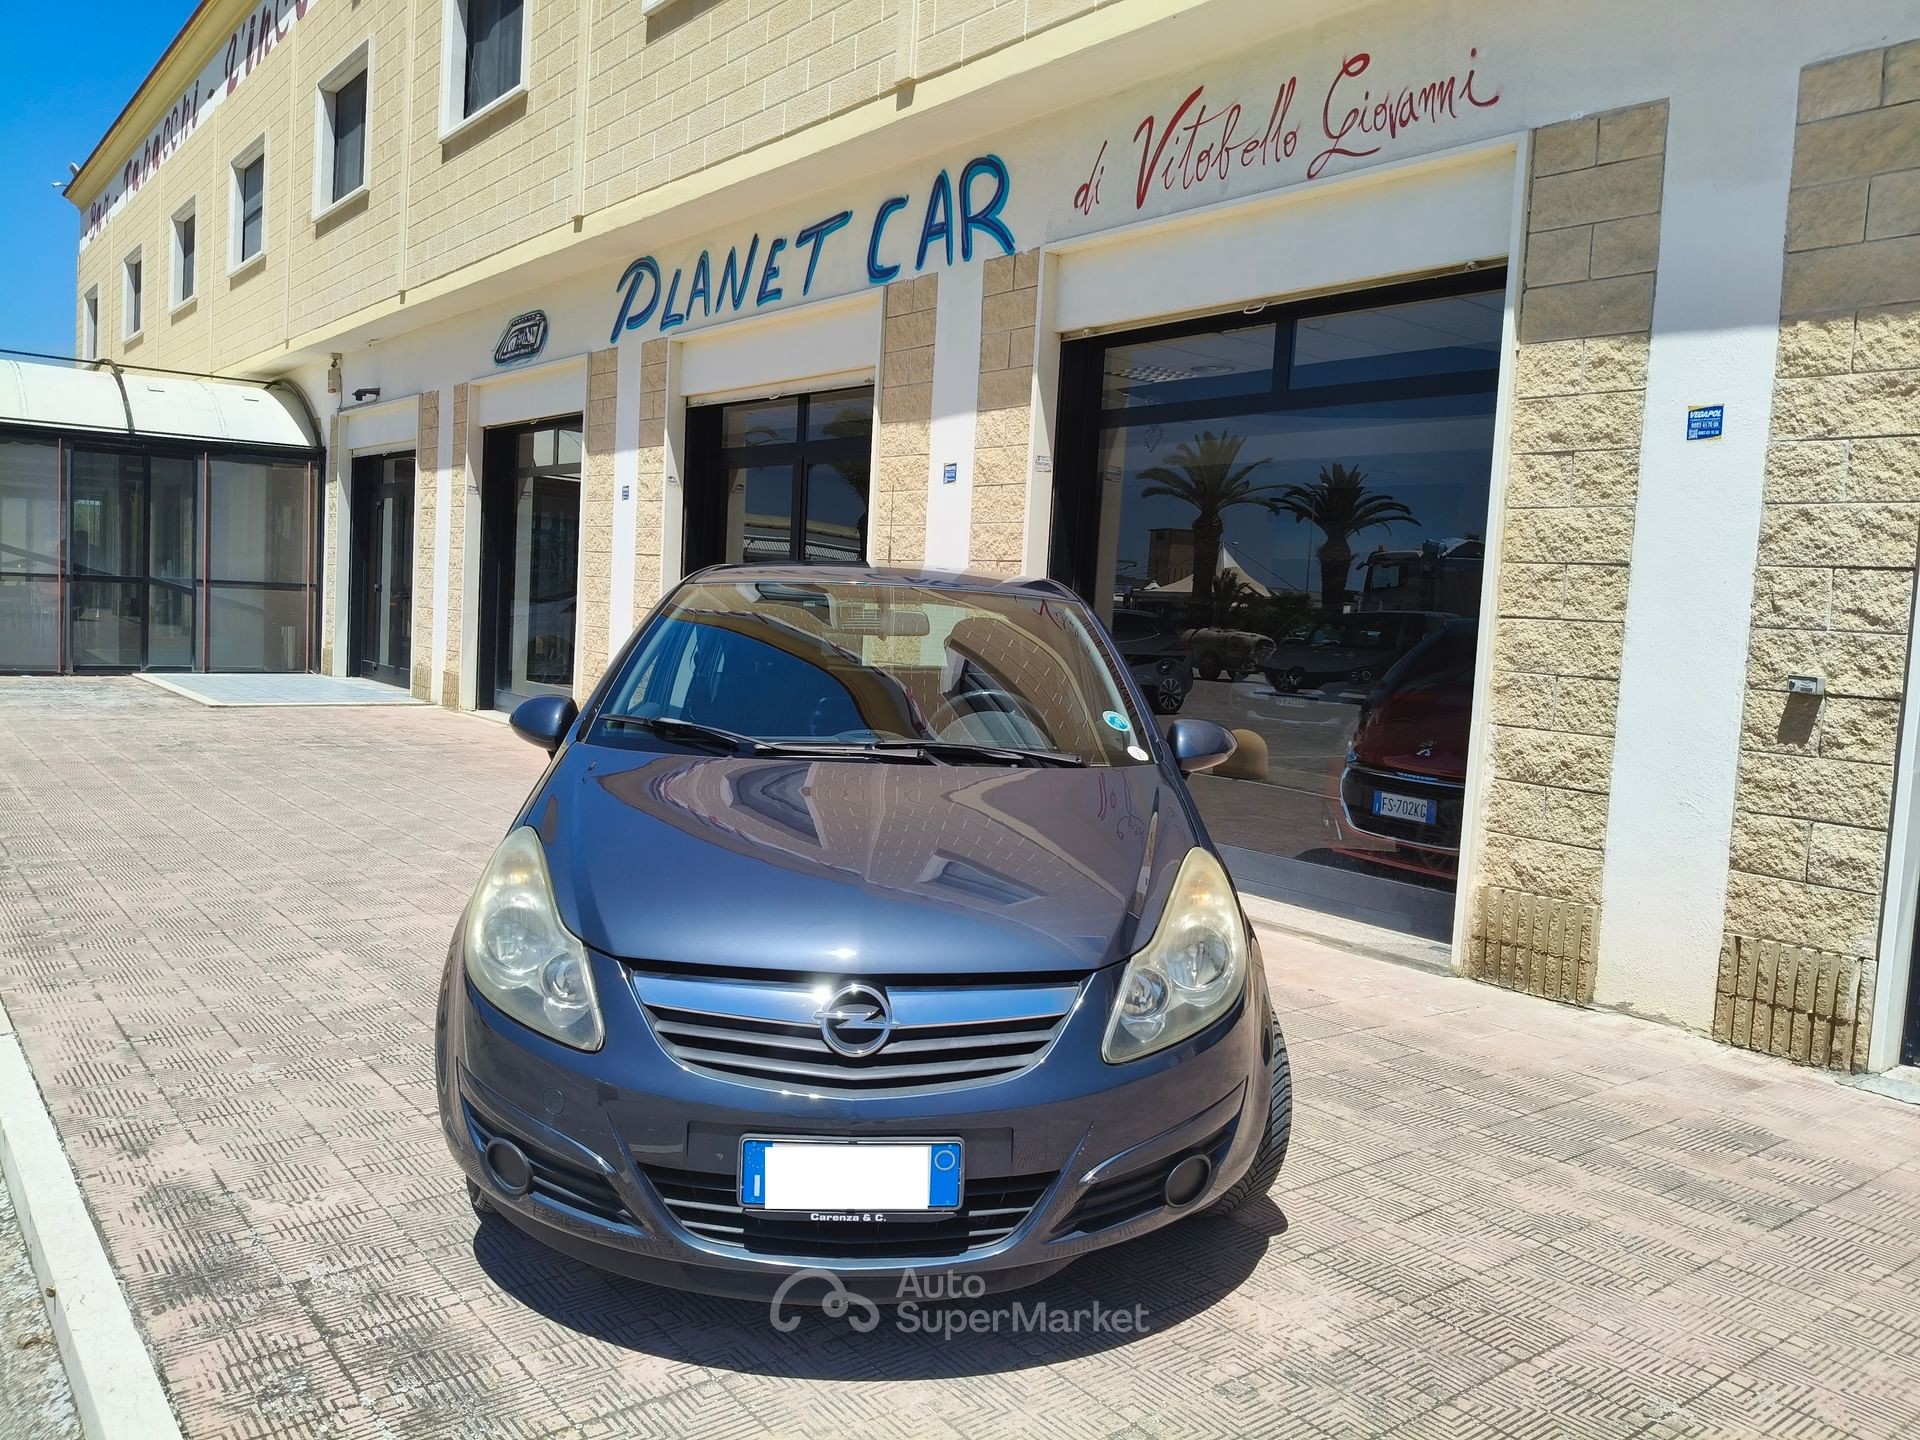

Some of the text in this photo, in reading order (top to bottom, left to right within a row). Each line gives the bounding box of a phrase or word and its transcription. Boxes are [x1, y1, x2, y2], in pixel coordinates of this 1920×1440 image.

[1073, 140, 1109, 216] di
[1306, 47, 1501, 181] Giovanni
[610, 154, 1016, 344] PLANET CAR
[810, 1213, 887, 1222] Carenza & C.
